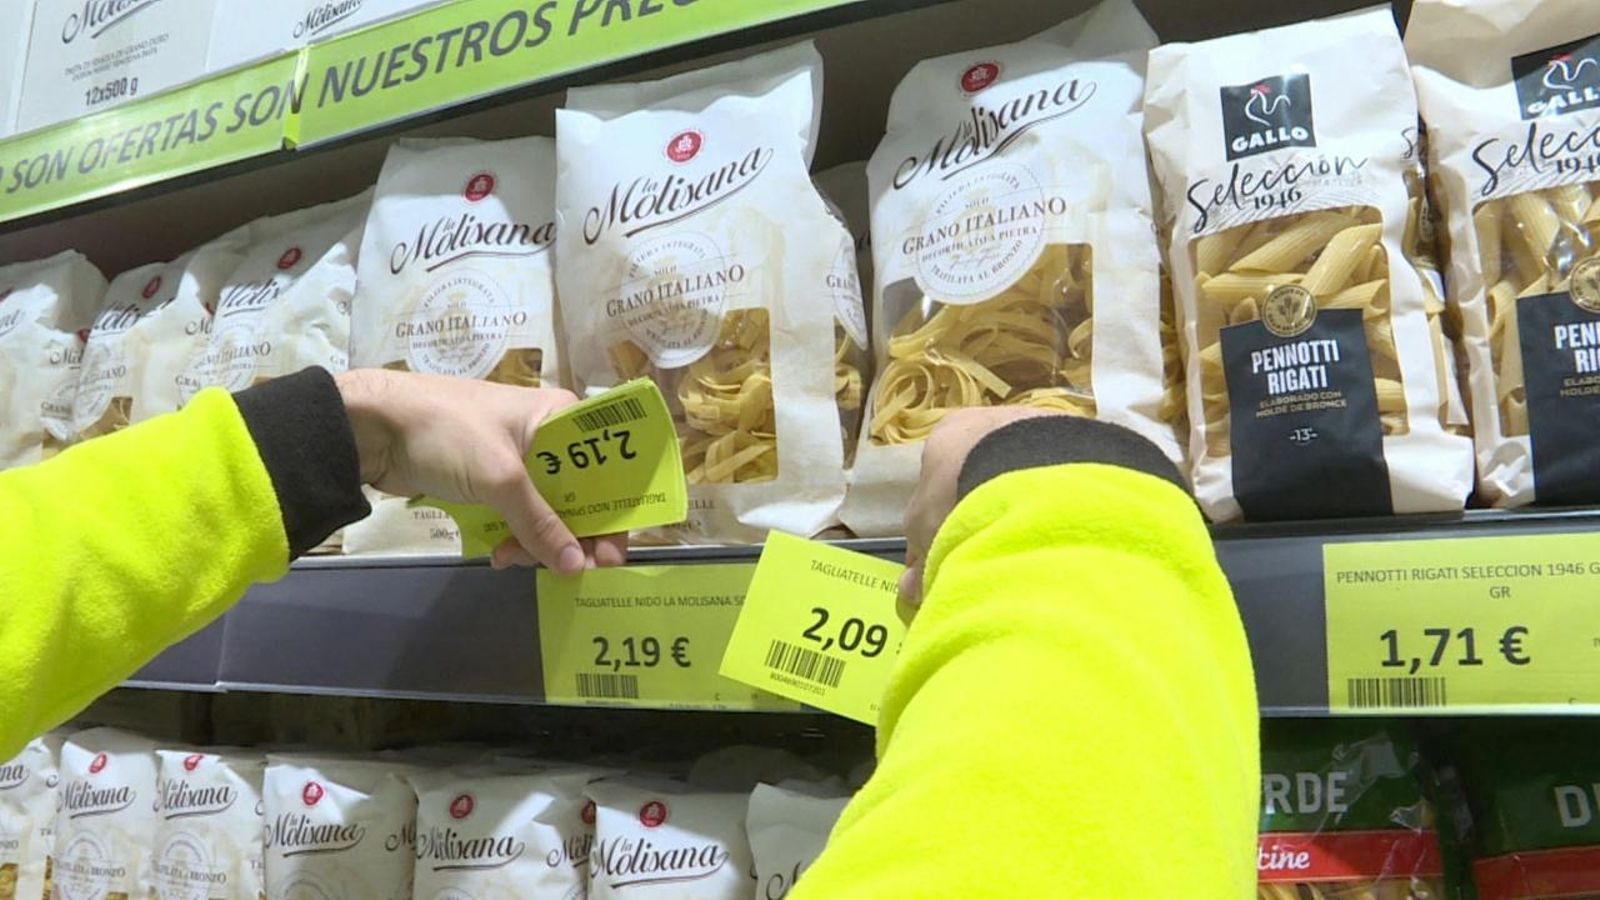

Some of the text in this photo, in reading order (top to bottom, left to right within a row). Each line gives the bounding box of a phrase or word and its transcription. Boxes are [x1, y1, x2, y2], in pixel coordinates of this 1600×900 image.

[6, 145, 75, 194] SON
[78, 101, 223, 175] OFERTAS
[226, 73, 310, 133] SON
[317, 1, 557, 108] NUESTROS
[86, 77, 138, 106] 12x500 g
[893, 79, 1098, 190] Molisana
[1231, 126, 1309, 152] GALLO
[583, 147, 774, 246] Molisana
[1253, 187, 1303, 210] 1946
[390, 212, 557, 275] Molisana
[902, 196, 1067, 255] GRANO ITALIANO
[606, 264, 745, 318] GRANO ITALIANO
[395, 311, 528, 339] GRANO ITALIANO
[1251, 339, 1340, 374] PENNOTTI
[1268, 366, 1328, 395] RIGATI
[1256, 399, 1348, 418] MOLDE DE BRONCE
[1259, 391, 1342, 408] ELABORADO CON
[536, 429, 637, 475] 2,19 €
[810, 560, 879, 590] TAGLIATELLE
[1337, 568, 1409, 584] PENNOTTI
[1412, 567, 1458, 581] RIGATI
[1462, 564, 1543, 580] SELECCION
[1548, 562, 1585, 577] 1946
[575, 597, 633, 609] TAGLIATELLE
[635, 597, 662, 608] NIDO
[664, 596, 677, 607] LA
[1489, 585, 1512, 600] GR
[802, 607, 888, 658] 2,09
[1380, 625, 1531, 675] 1,71 €
[592, 636, 692, 673] 2,19 €
[1262, 771, 1350, 815] RDE
[264, 813, 366, 857] Molisana
[590, 836, 730, 890] Molisana
